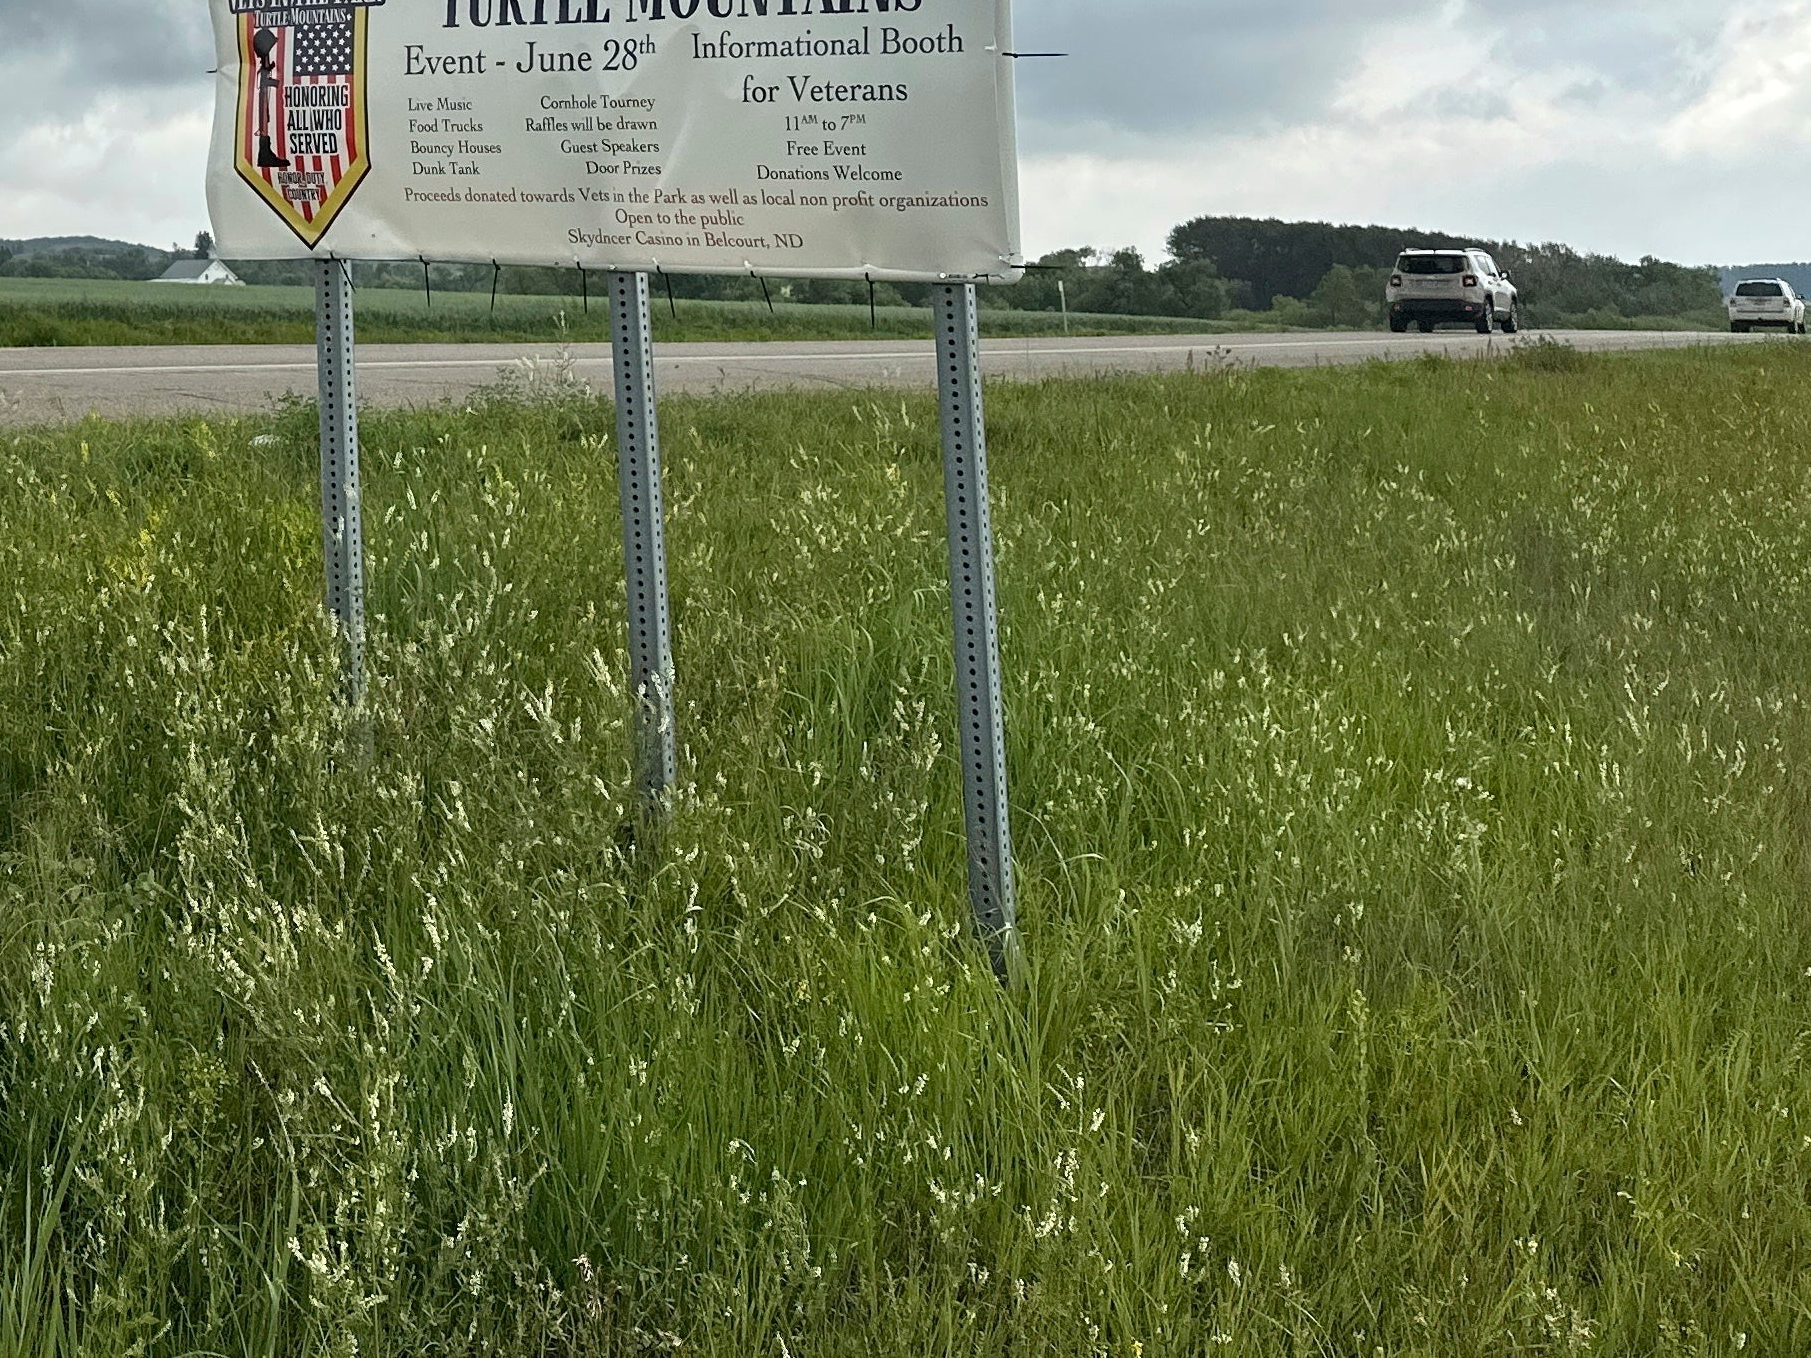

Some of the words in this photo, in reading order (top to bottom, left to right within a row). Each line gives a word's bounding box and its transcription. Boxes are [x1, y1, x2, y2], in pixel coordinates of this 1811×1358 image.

[254, 9, 288, 26] TURTLE
[291, 7, 346, 25] MOUNTAINS
[692, 26, 870, 59] Informational
[881, 24, 965, 55] Booth
[404, 44, 487, 76] Event
[516, 41, 592, 73] June
[602, 34, 657, 72] 28th
[284, 85, 349, 108] HONORING
[742, 74, 780, 103] for
[787, 75, 908, 102] Veterans
[408, 97, 433, 111] Live
[437, 97, 472, 111] Music
[540, 94, 598, 110] Cornhole
[600, 95, 656, 112] Tourney
[287, 109, 309, 131] ALL
[311, 108, 342, 131] WHO
[409, 119, 439, 133] Food
[442, 119, 484, 133] Trucks
[525, 117, 568, 132] Raffles
[571, 117, 593, 131] will
[597, 117, 614, 131] be
[616, 116, 657, 130] drawn
[784, 114, 818, 131] 11AM
[822, 117, 837, 131] to
[840, 113, 867, 131] 7PM
[289, 132, 338, 155] SERVED
[410, 140, 454, 157] Bouncy
[458, 140, 502, 155] Houses
[560, 139, 598, 154] Guest
[601, 139, 660, 156] Speakers
[787, 141, 819, 157] Free
[823, 141, 867, 157] Event
[412, 161, 446, 175] Dunk
[449, 161, 481, 175] Tank
[585, 161, 620, 175] Door
[623, 161, 662, 175] Prizes
[756, 164, 830, 181] Donations
[833, 164, 903, 181] Welcome
[404, 187, 461, 203] Proceeds
[464, 187, 517, 203] donated
[520, 187, 576, 203] towards
[579, 187, 610, 203] Vets
[613, 187, 625, 203] in
[628, 188, 649, 204] the
[654, 188, 688, 204] Park
[691, 193, 706, 205] as
[708, 190, 739, 205] well
[742, 194, 758, 206] as
[761, 190, 796, 206] local
[799, 195, 828, 207] non
[832, 190, 875, 211] profit
[879, 190, 989, 211] organizations
[615, 208, 653, 228] Open
[656, 211, 671, 225] to
[674, 209, 697, 226] the
[701, 209, 745, 228] public
[568, 228, 632, 249] Skydncer
[636, 230, 684, 247] Casino
[687, 230, 700, 247] in
[705, 232, 771, 250] Belcourt,
[773, 233, 804, 249] ND
